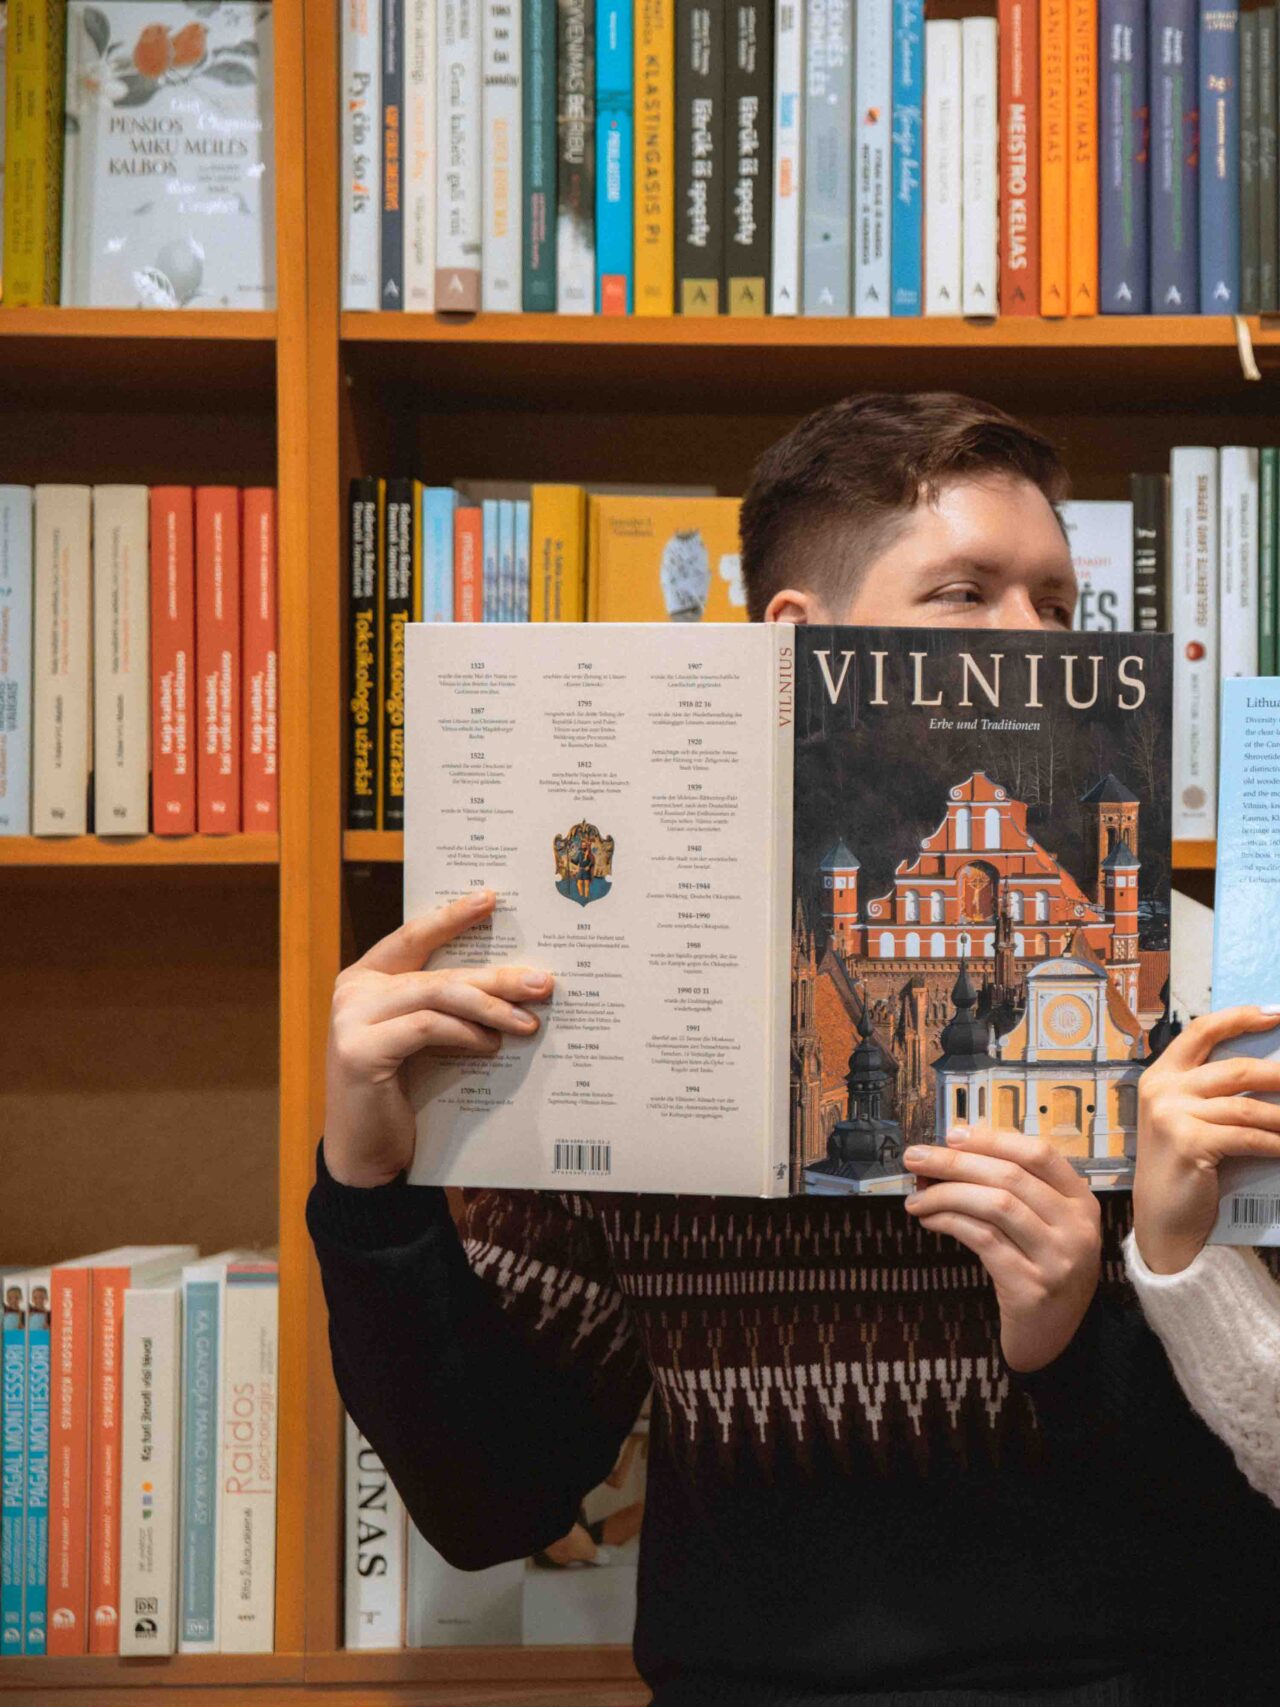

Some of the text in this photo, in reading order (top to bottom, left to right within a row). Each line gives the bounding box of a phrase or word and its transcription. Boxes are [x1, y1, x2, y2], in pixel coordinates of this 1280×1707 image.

[644, 54, 661, 245] KLASTINGASIS PI
[1008, 104, 1027, 194] MEISTRO
[1008, 198, 1027, 271] KELIAS
[350, 608, 374, 796] Toksikologo užrašai
[778, 646, 793, 728] VILNIUS
[813, 650, 1147, 710] VILNIUS
[928, 718, 1041, 731] Erbe und Traditionen
[4, 1344, 25, 1508] PAGAL MONTESSORI
[28, 1344, 49, 1508] PAGAL MONTESSORI
[225, 1382, 270, 1496] Raidos
[258, 1381, 273, 1481] psichologija
[357, 1434, 388, 1578] UNAS
[136, 1599, 157, 1612] DK
